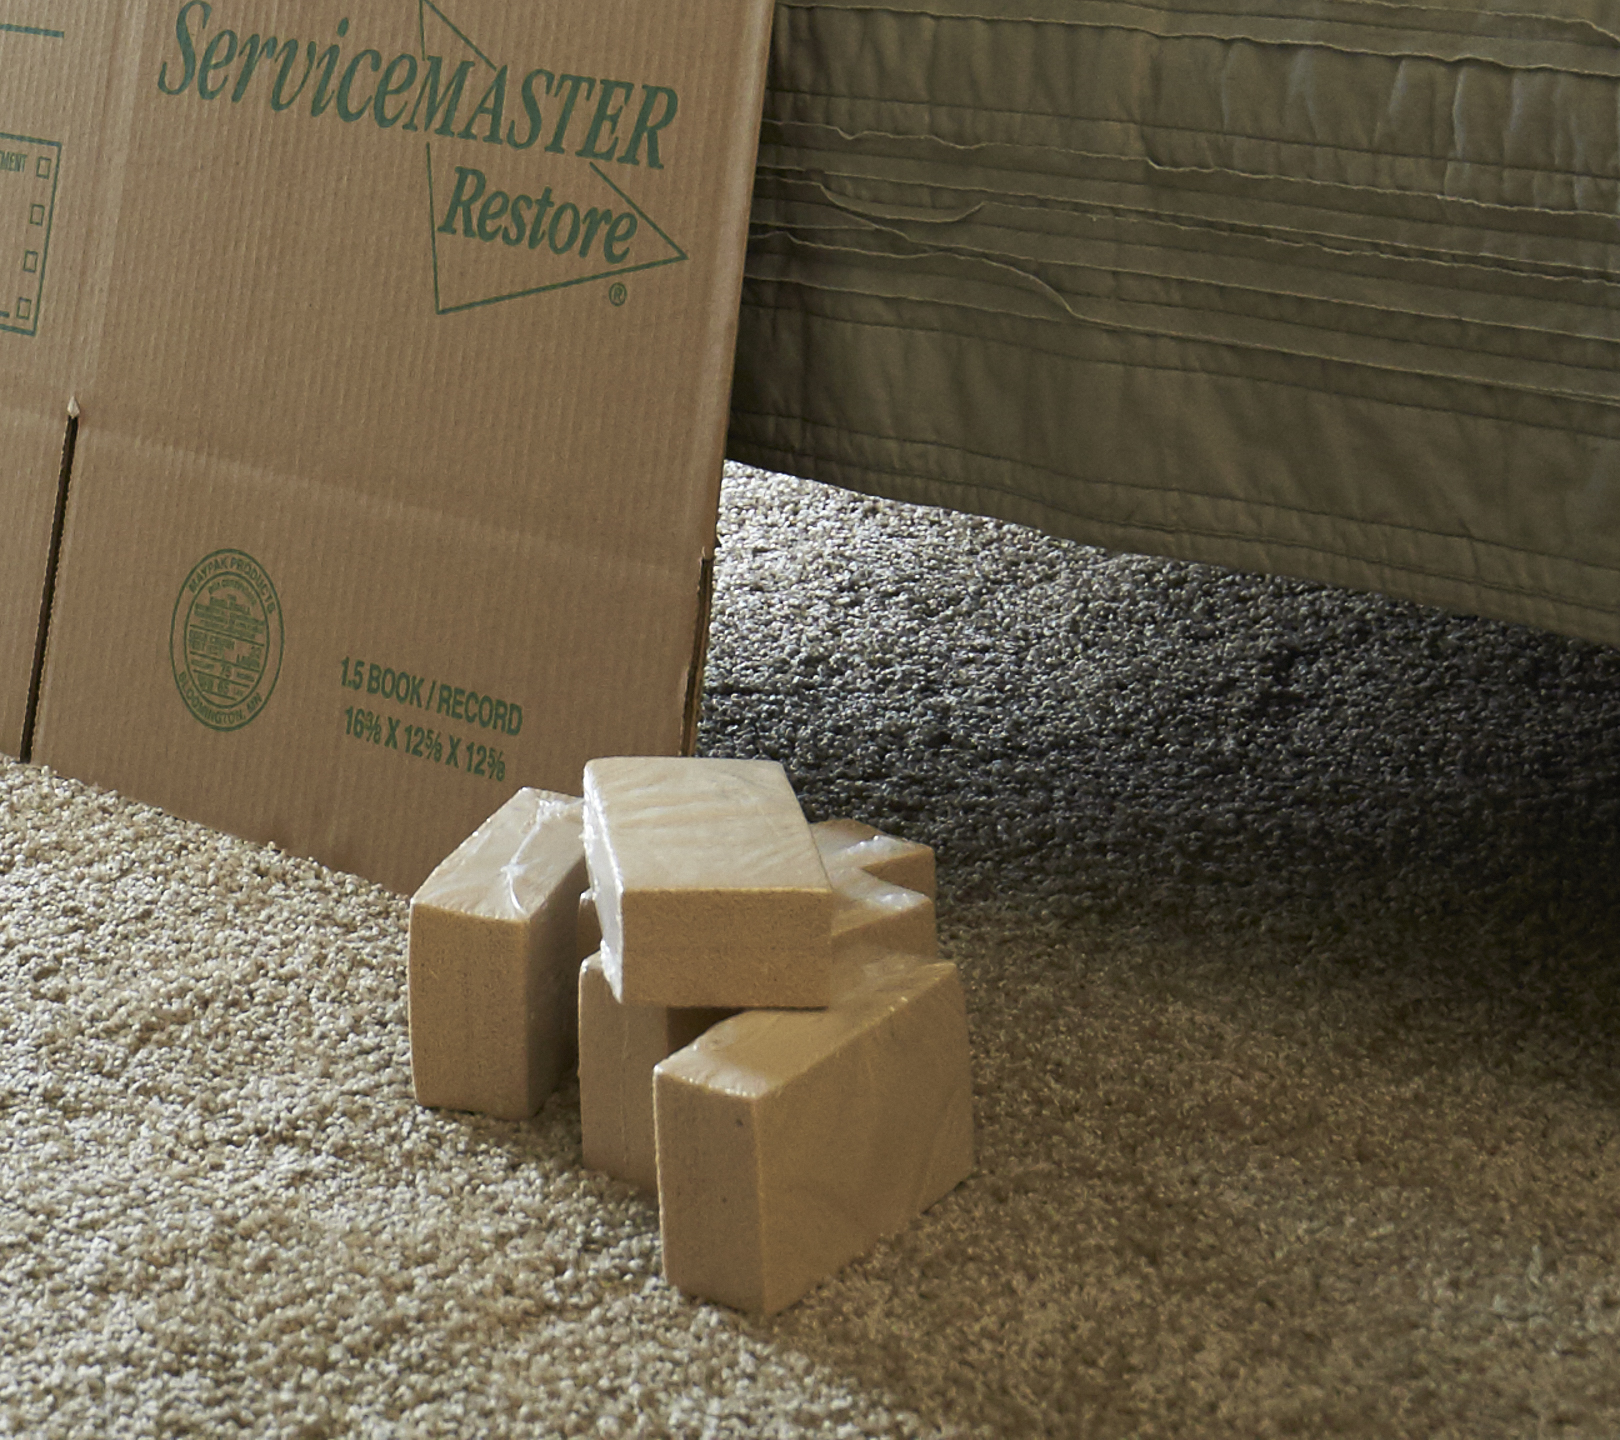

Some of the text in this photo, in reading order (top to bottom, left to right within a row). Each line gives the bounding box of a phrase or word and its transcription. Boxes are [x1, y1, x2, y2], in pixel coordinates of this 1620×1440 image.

[157, 0, 678, 170] ServiceMASTER
[438, 166, 638, 264] Restore
[230, 557, 276, 614] PRODUCTS
[341, 656, 365, 690] 1.5
[366, 663, 425, 709] BOOK
[436, 683, 523, 736] RECORD
[384, 716, 401, 750] X
[445, 734, 462, 769] X
